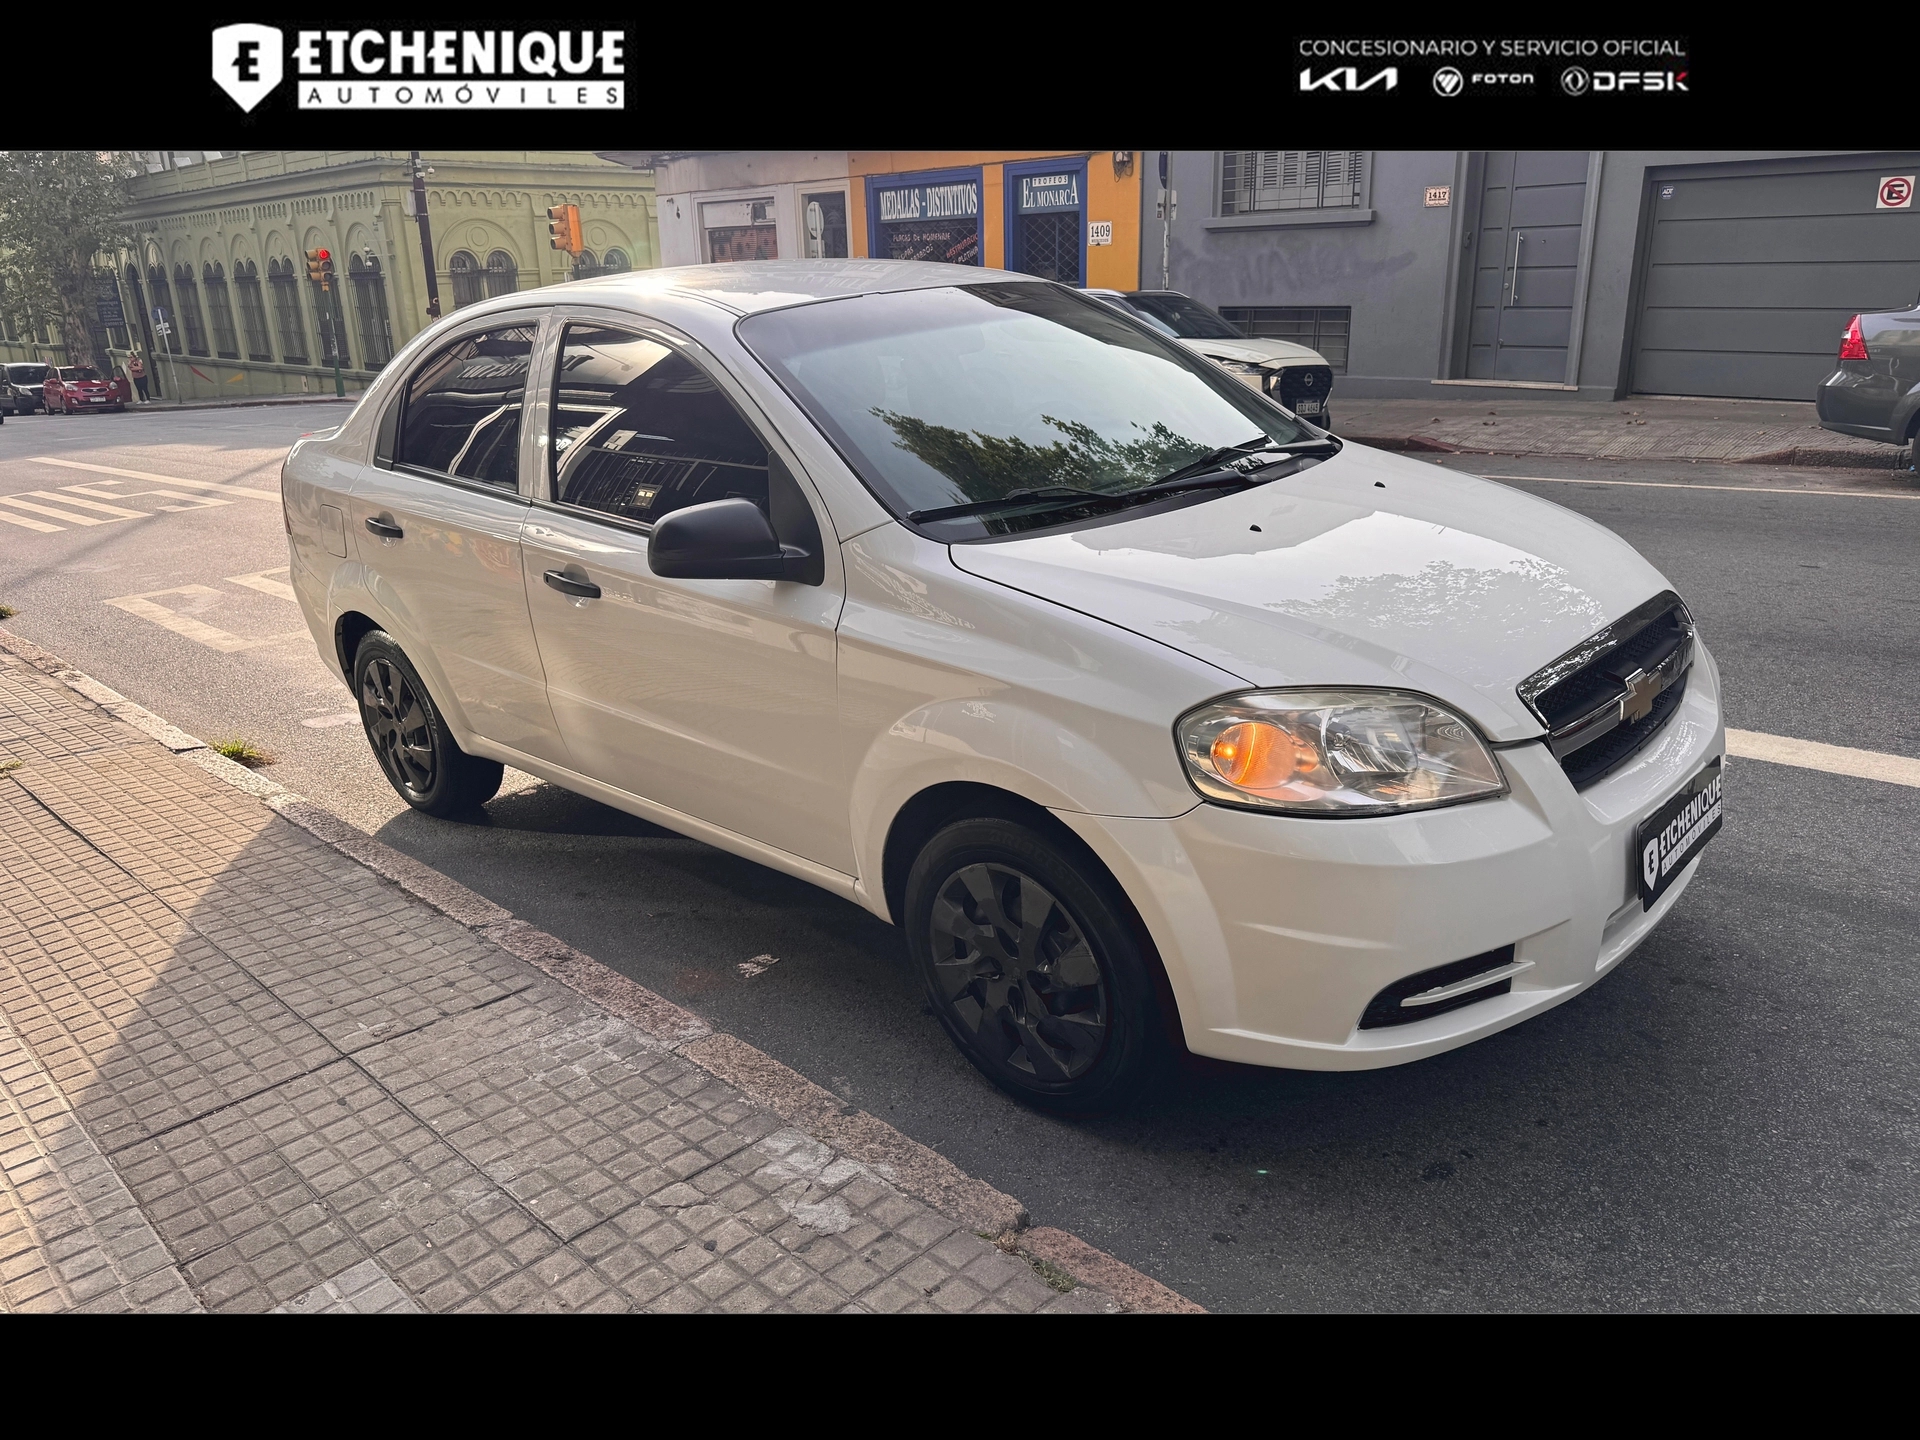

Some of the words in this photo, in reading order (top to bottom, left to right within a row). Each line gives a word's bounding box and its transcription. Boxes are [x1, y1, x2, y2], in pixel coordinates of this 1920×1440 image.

[1034, 175, 1067, 186] TROFEOS
[1037, 174, 1079, 207] MONARCA
[880, 188, 920, 220] MEDALLAS
[926, 183, 978, 217] DISTINTIVOS
[1091, 225, 1110, 238] 1409
[1660, 774, 1721, 858] ETCHENIQUE
